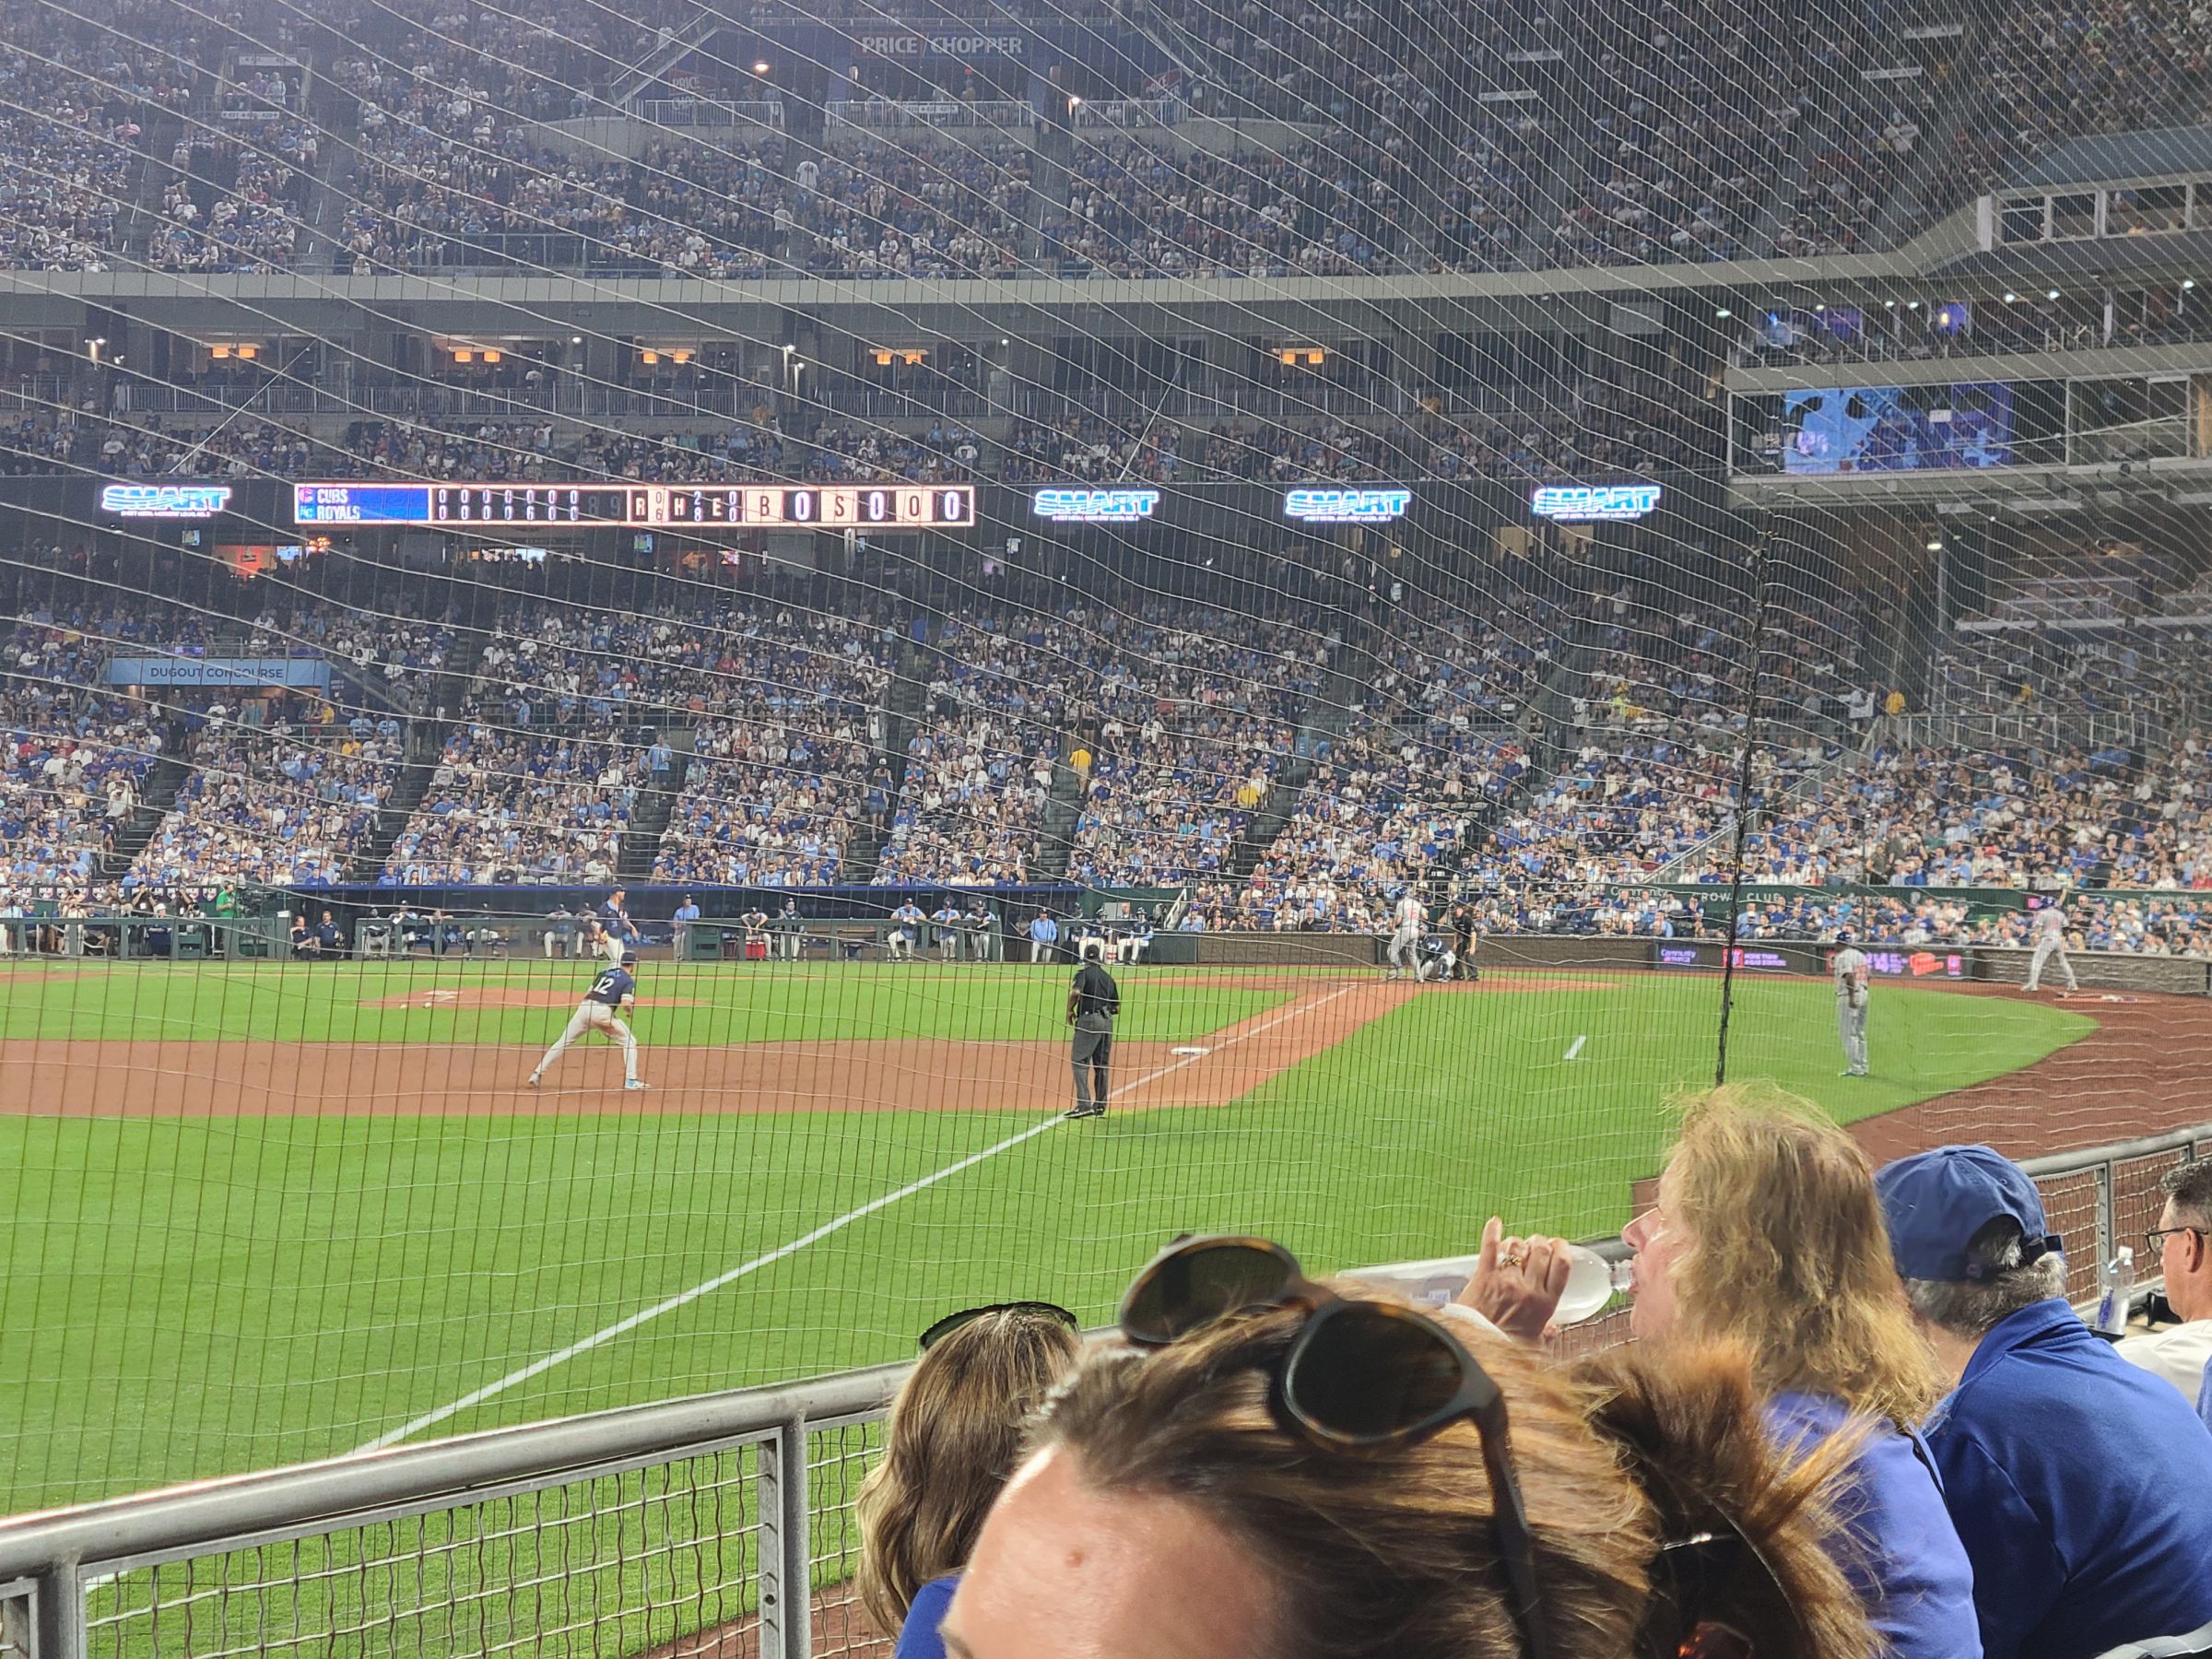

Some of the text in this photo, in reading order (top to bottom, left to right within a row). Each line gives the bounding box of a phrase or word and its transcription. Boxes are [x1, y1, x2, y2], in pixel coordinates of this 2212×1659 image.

[862, 36, 1023, 54] PRICE CHOPPER
[101, 485, 231, 512] SMART
[317, 488, 348, 504] CUBS
[439, 488, 446, 504] 0
[461, 488, 468, 504] 0
[483, 488, 490, 504] 0
[505, 488, 512, 504] 0
[526, 488, 534, 504] 0
[548, 488, 556, 504] 0
[571, 488, 578, 504] 0
[636, 498, 645, 516] R
[655, 491, 662, 504] 0
[673, 497, 686, 516] H
[693, 489, 701, 505] 2
[712, 497, 722, 516] E
[759, 495, 770, 516] B
[795, 491, 810, 521] 0
[835, 495, 844, 517] S
[869, 491, 885, 521] 0
[945, 491, 959, 521] 0
[1034, 490, 1159, 515] SMART
[1286, 490, 1411, 516] SMART
[1533, 487, 1661, 513] SMART
[317, 505, 360, 520] ROYALS
[655, 508, 662, 521] 6
[693, 506, 701, 522] 8
[149, 667, 284, 678] DUGOUT CONCOURSE
[593, 976, 615, 995] 12
